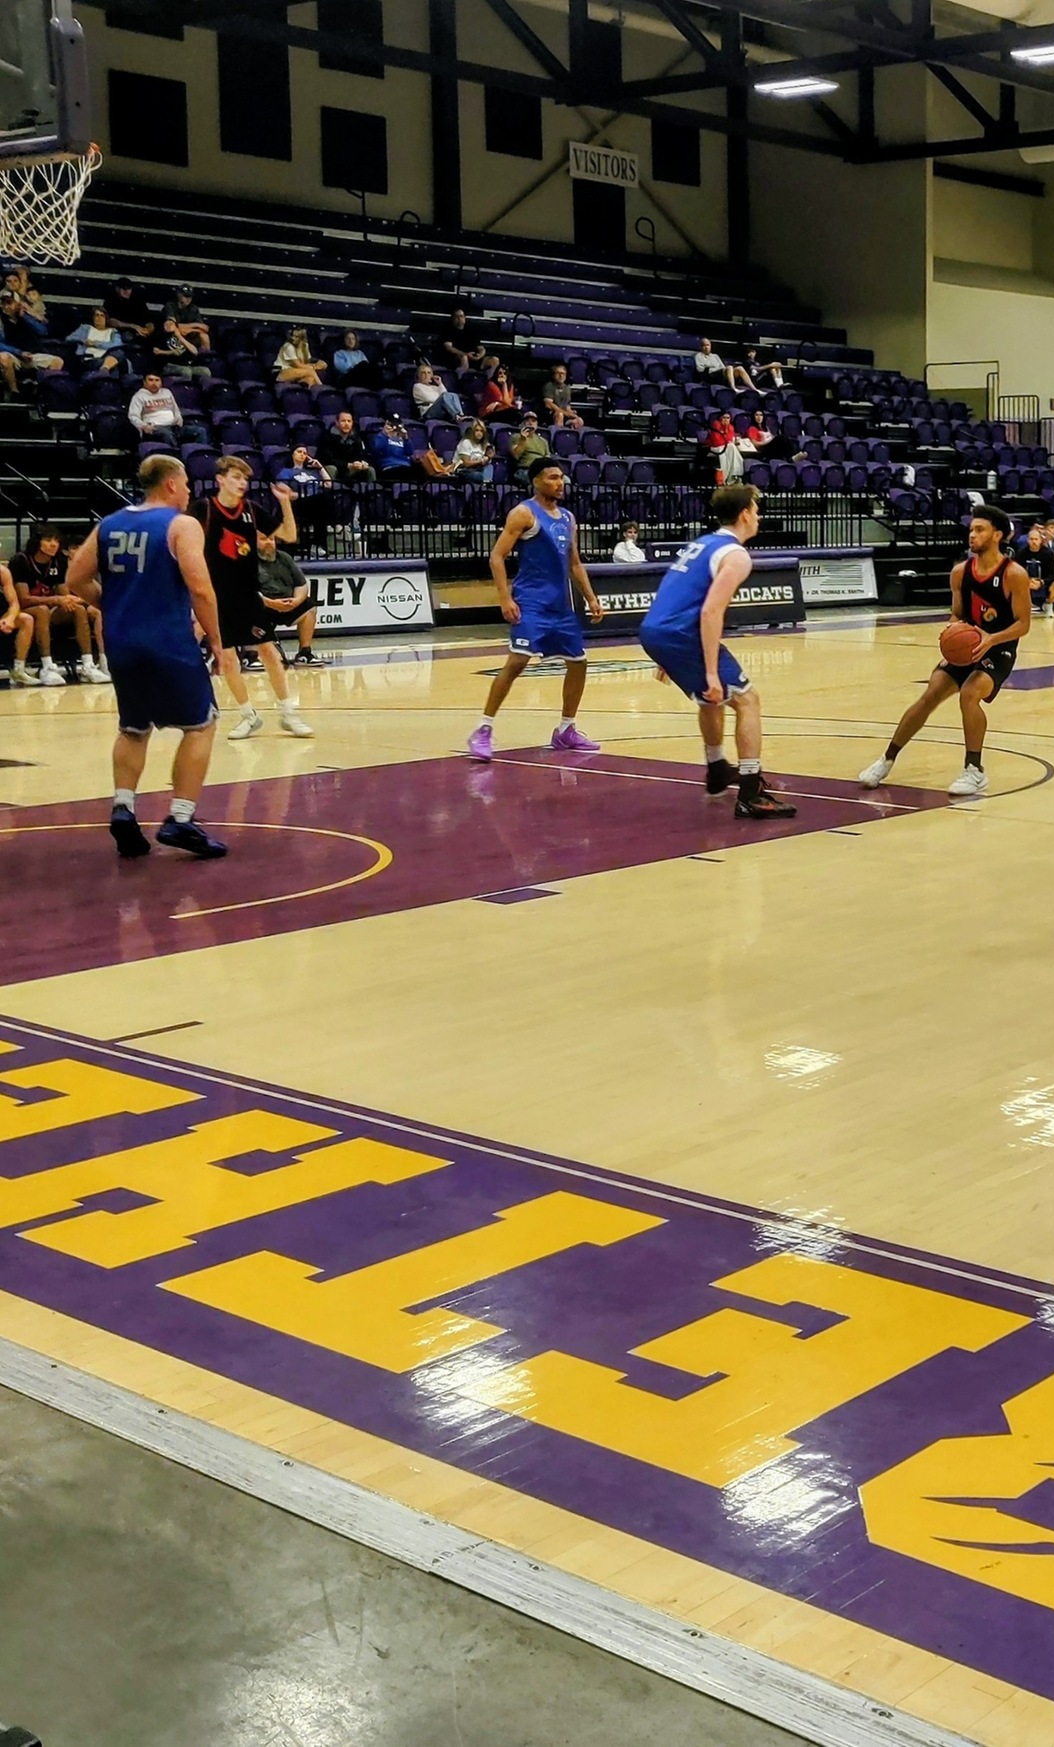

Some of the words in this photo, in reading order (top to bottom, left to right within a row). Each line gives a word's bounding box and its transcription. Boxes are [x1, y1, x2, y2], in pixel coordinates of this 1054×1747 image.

[573, 147, 637, 182] VISITORS
[107, 531, 149, 574] 24
[800, 565, 821, 576] ITH
[993, 575, 999, 588] 0
[377, 593, 423, 603] NISSAN
